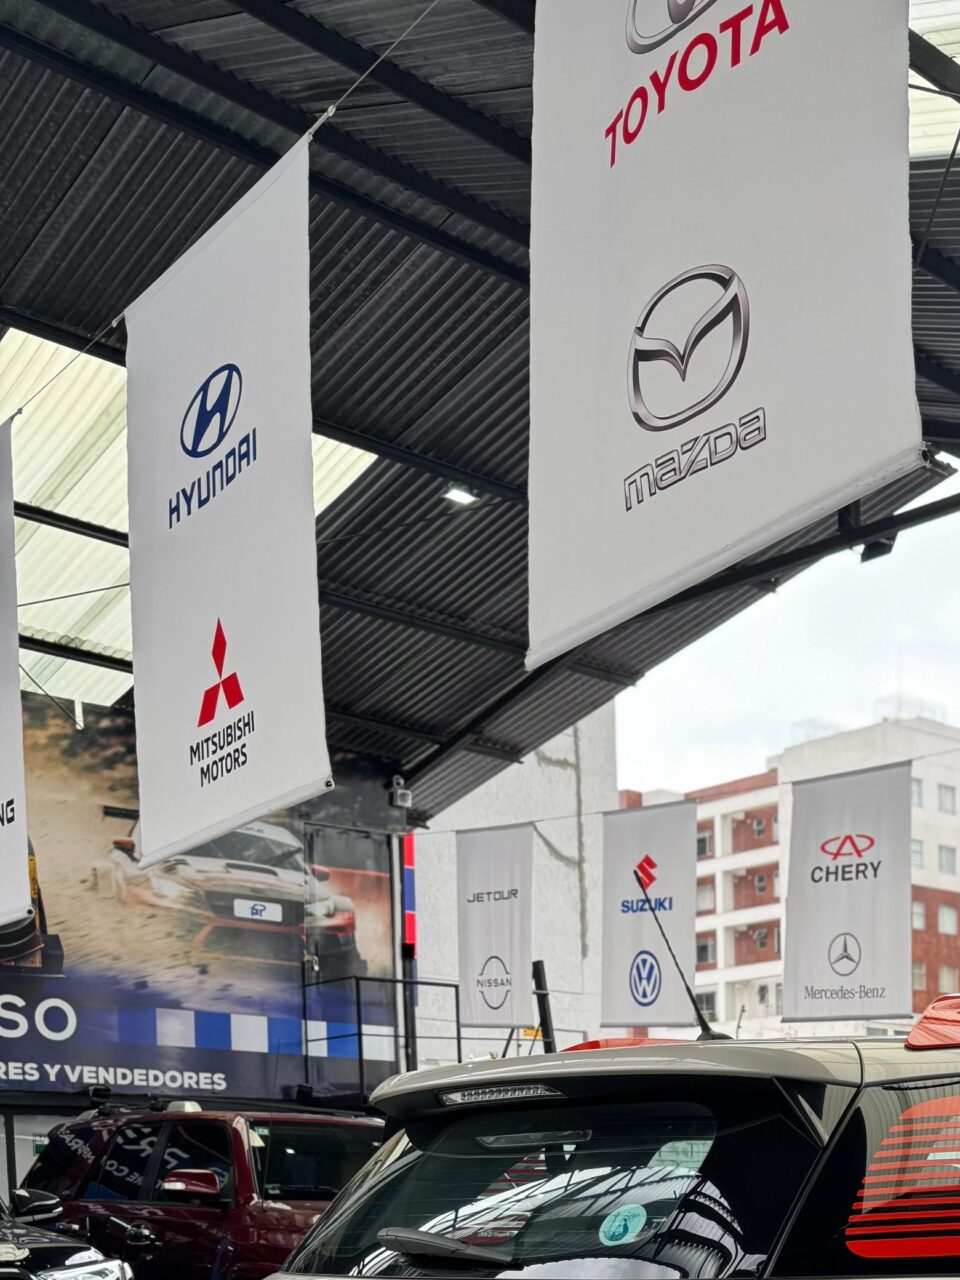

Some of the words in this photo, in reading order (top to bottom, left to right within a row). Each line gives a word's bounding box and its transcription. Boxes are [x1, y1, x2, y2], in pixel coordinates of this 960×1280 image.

[604, 0, 790, 167] TOYOTA
[167, 426, 257, 530] HYUNDAI
[189, 709, 255, 767] MITSUBISHI
[199, 742, 248, 788] MOTORS
[810, 859, 882, 884] CHERY
[466, 887, 519, 904] JETOUR
[620, 896, 673, 914] SUZUKI
[476, 976, 512, 988] NISSAN
[804, 985, 886, 1000] Mercedes-Benz
[43, 1064, 63, 1082] Y
[64, 1064, 227, 1091] VENDEDORES
